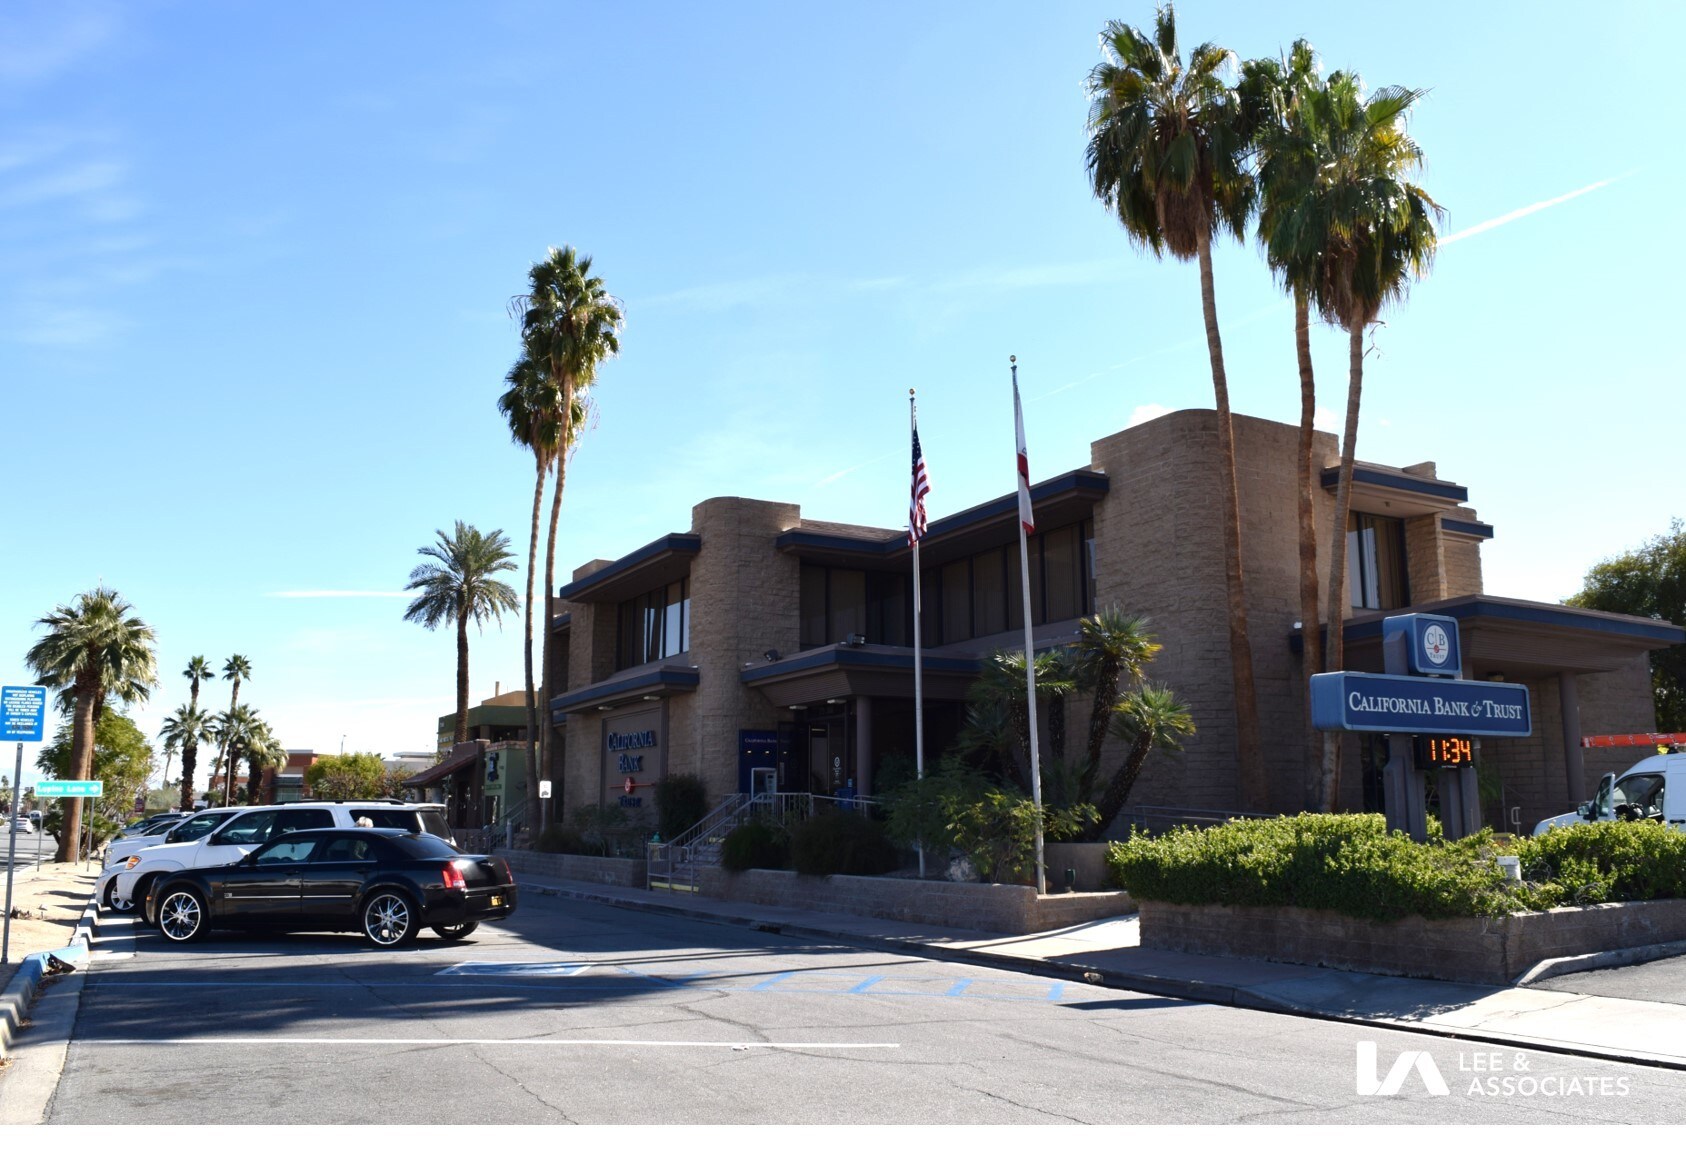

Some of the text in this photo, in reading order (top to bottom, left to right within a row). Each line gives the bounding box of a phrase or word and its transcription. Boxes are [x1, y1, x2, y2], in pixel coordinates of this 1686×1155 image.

[1348, 691, 1522, 720] CALIFORNIA BANK & TRUST
[608, 731, 655, 752] CALIFORNIA
[1431, 738, 1471, 763] 11:34
[617, 753, 641, 774] BANK
